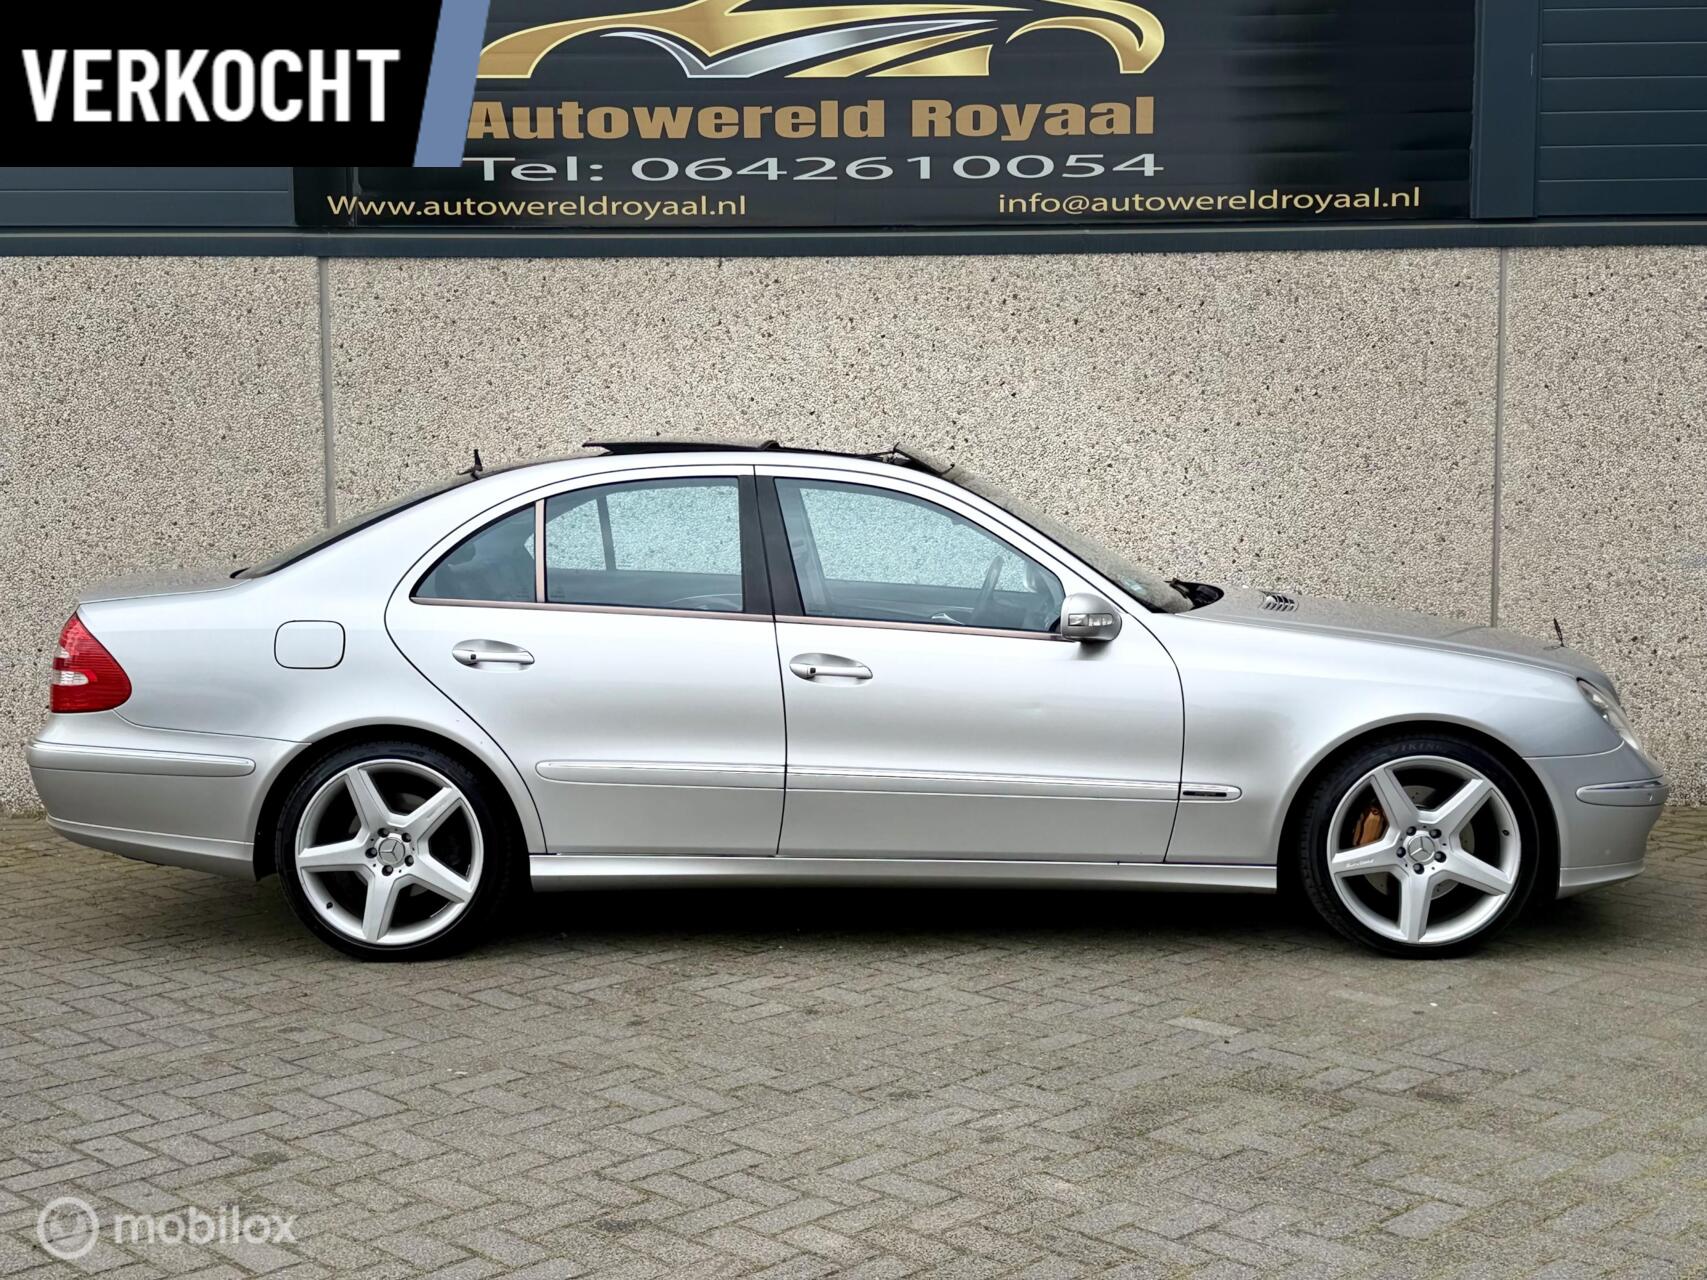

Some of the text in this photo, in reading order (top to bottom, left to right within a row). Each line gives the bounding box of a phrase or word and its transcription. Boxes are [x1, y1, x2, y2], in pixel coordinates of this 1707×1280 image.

[467, 96, 1154, 141] Autowereld Royaal
[463, 153, 1164, 181] Tel: 0642610054
[327, 195, 746, 221] Www.autowereldroyaal.nl
[999, 186, 1420, 214] info@autowereldroyaal.nl
